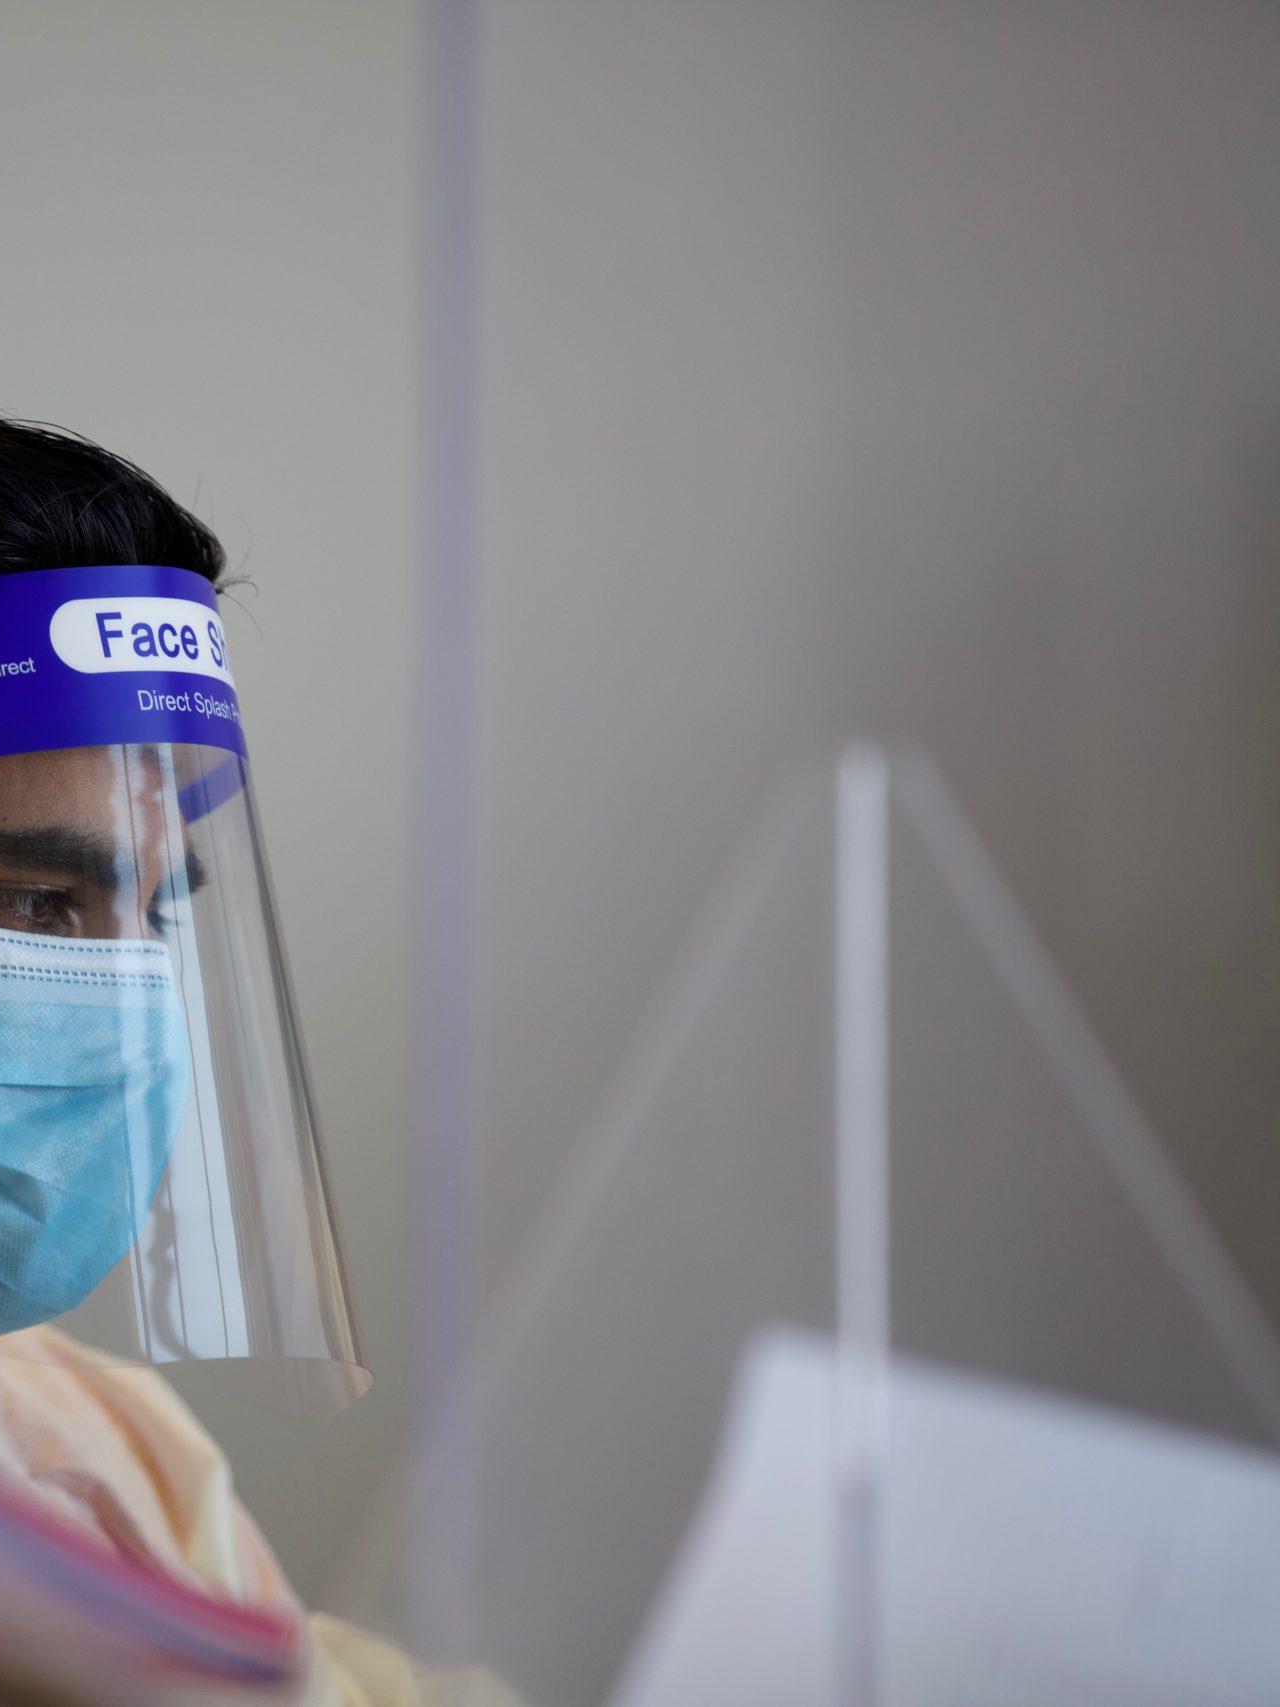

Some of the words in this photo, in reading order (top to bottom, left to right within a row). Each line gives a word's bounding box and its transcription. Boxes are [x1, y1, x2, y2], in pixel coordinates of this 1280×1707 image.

[95, 611, 199, 660] Face
[137, 690, 192, 712] Direct
[193, 692, 233, 720] Splash
